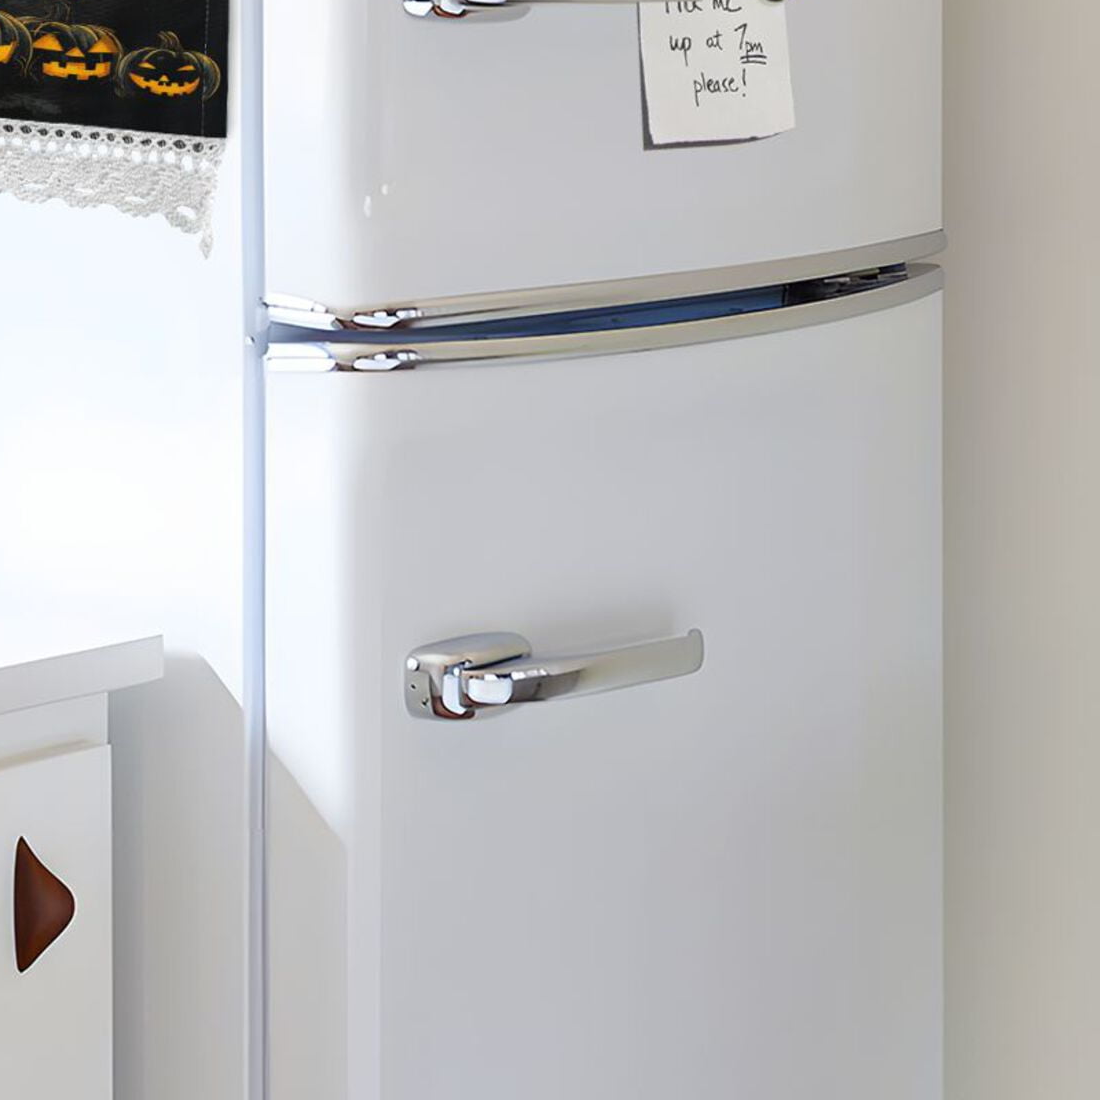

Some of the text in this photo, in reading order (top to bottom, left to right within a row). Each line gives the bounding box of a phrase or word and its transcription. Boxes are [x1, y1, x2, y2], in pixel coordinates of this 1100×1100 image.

[669, 34, 691, 67] up
[706, 29, 723, 50] at
[693, 68, 746, 107] please!
